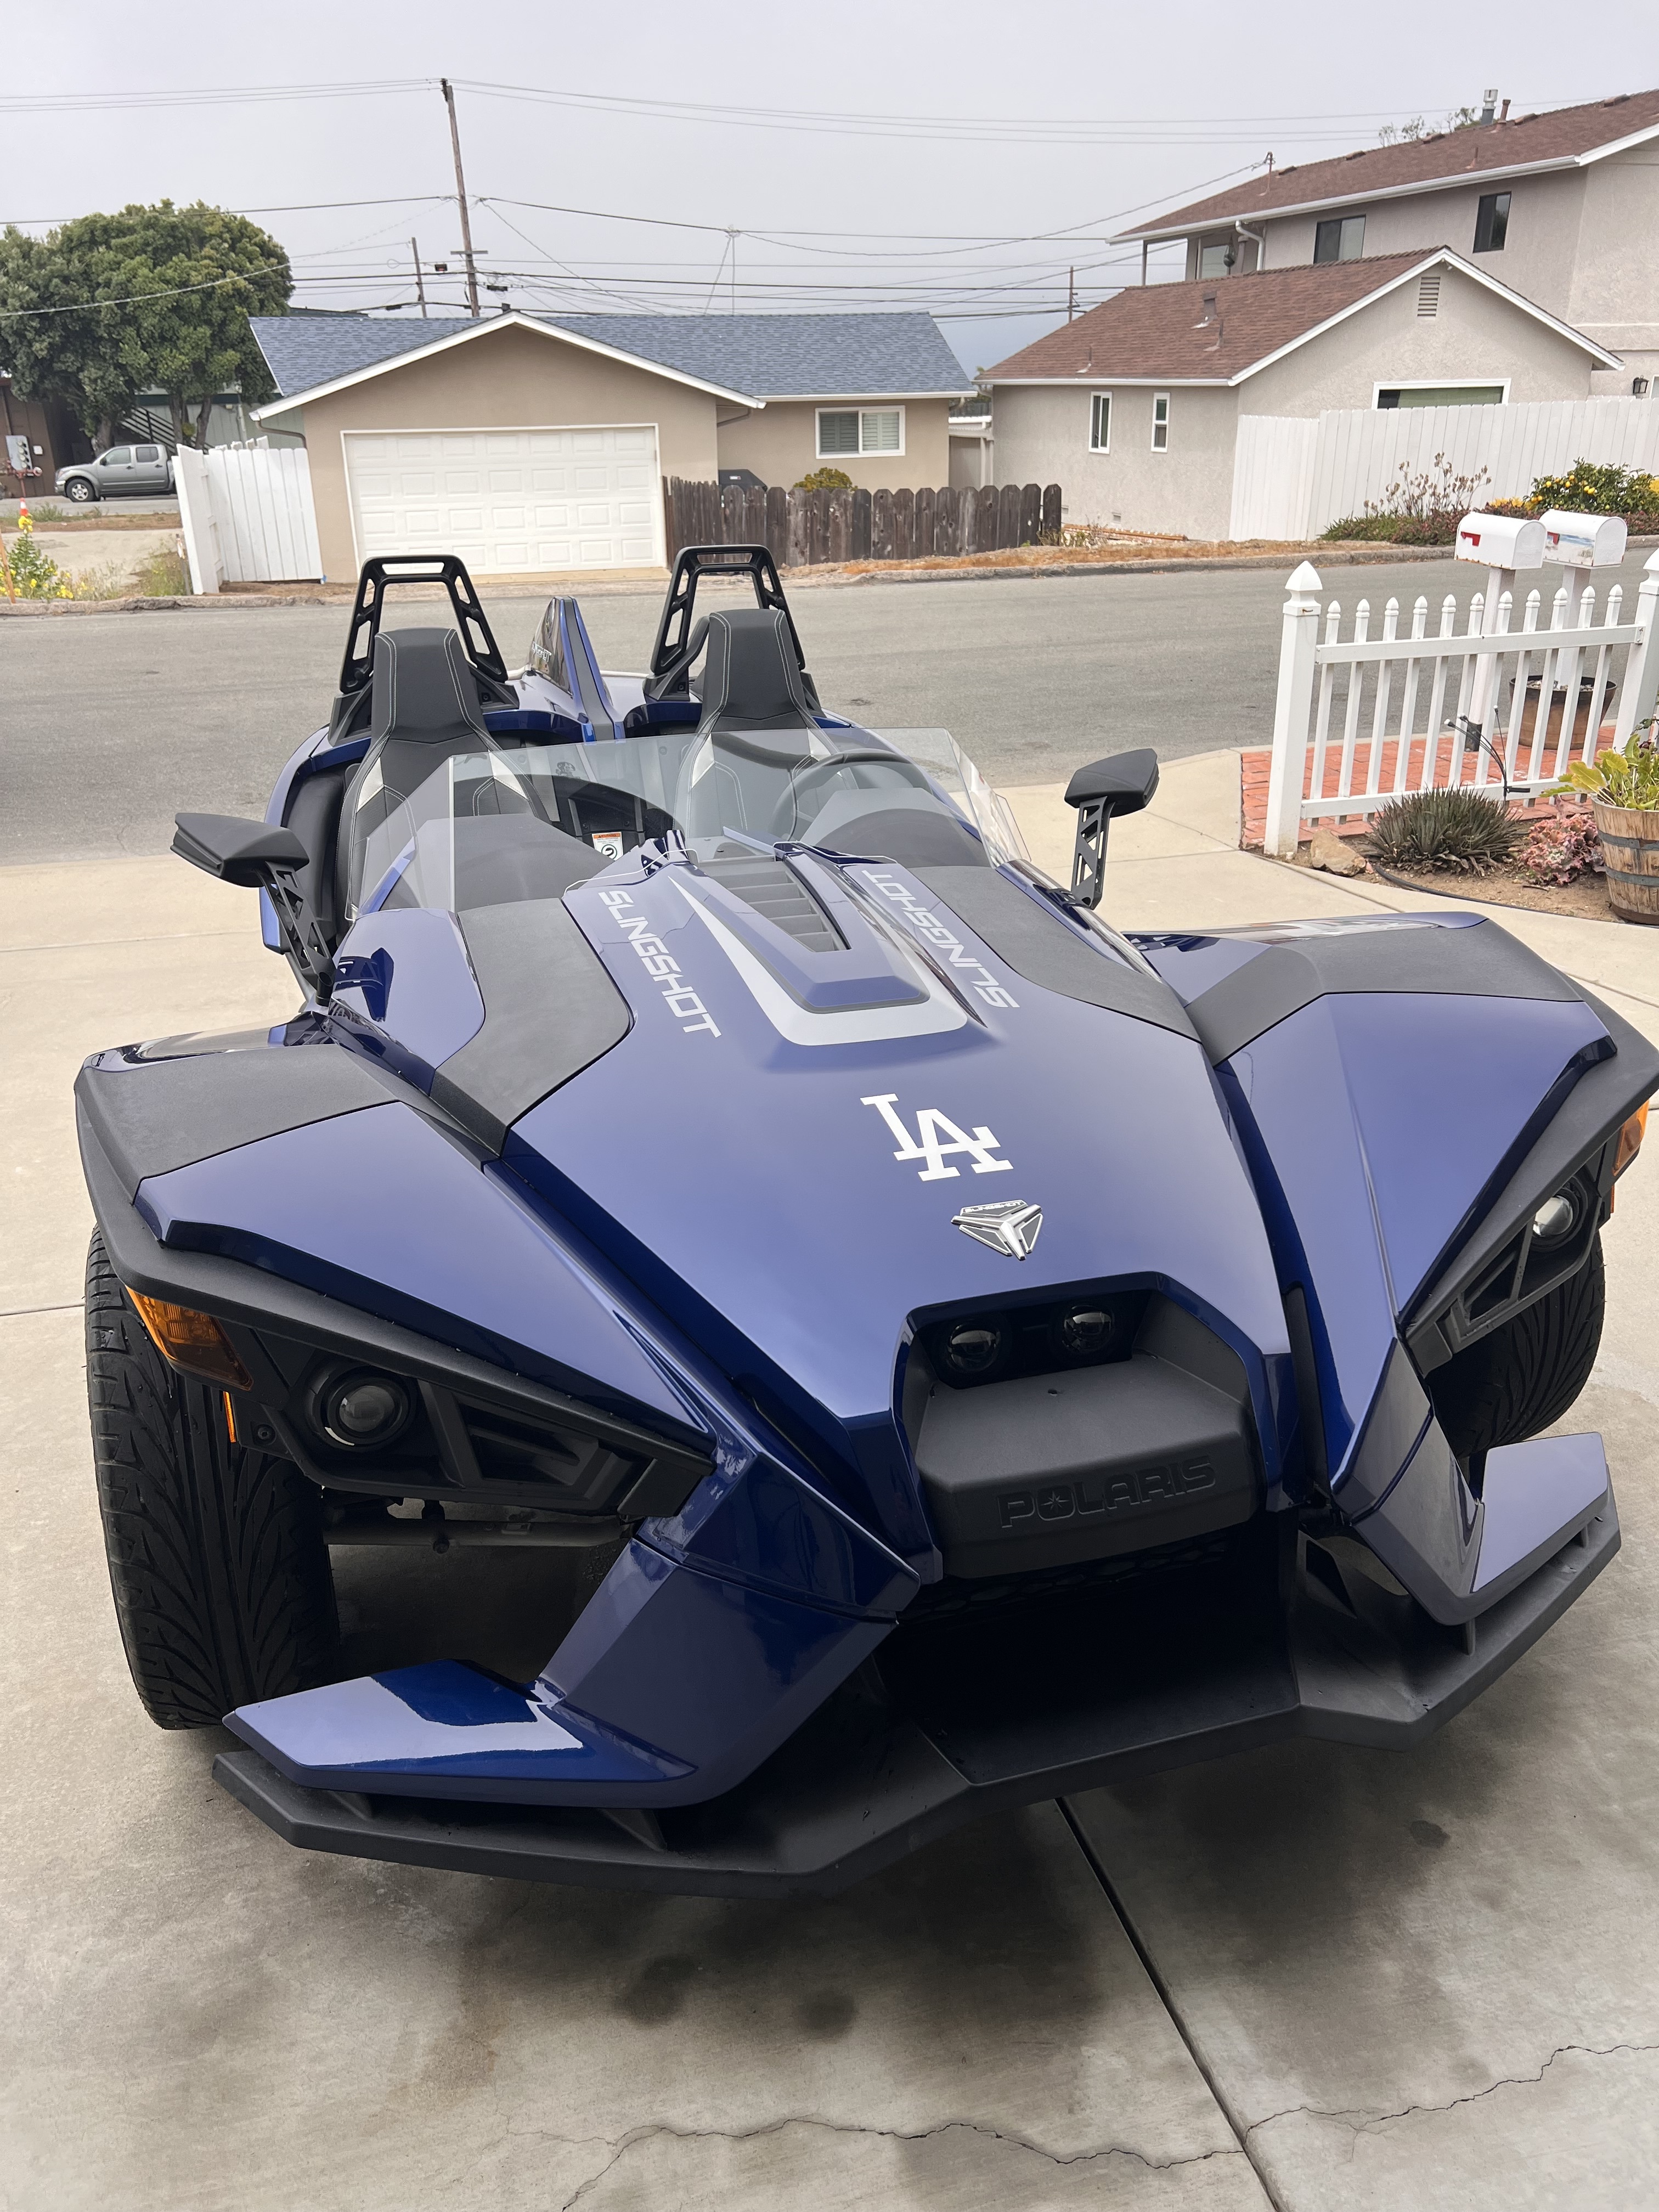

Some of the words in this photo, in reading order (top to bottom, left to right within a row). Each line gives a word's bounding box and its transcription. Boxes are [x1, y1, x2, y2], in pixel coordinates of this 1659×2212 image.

[598, 890, 722, 1039] SLINGSHOT
[861, 870, 1020, 1008] SLINGSHOT
[860, 1093, 1014, 1181] LA
[964, 1201, 1023, 1213] SLINGSHOT
[997, 1455, 1216, 1528] POLARIS
